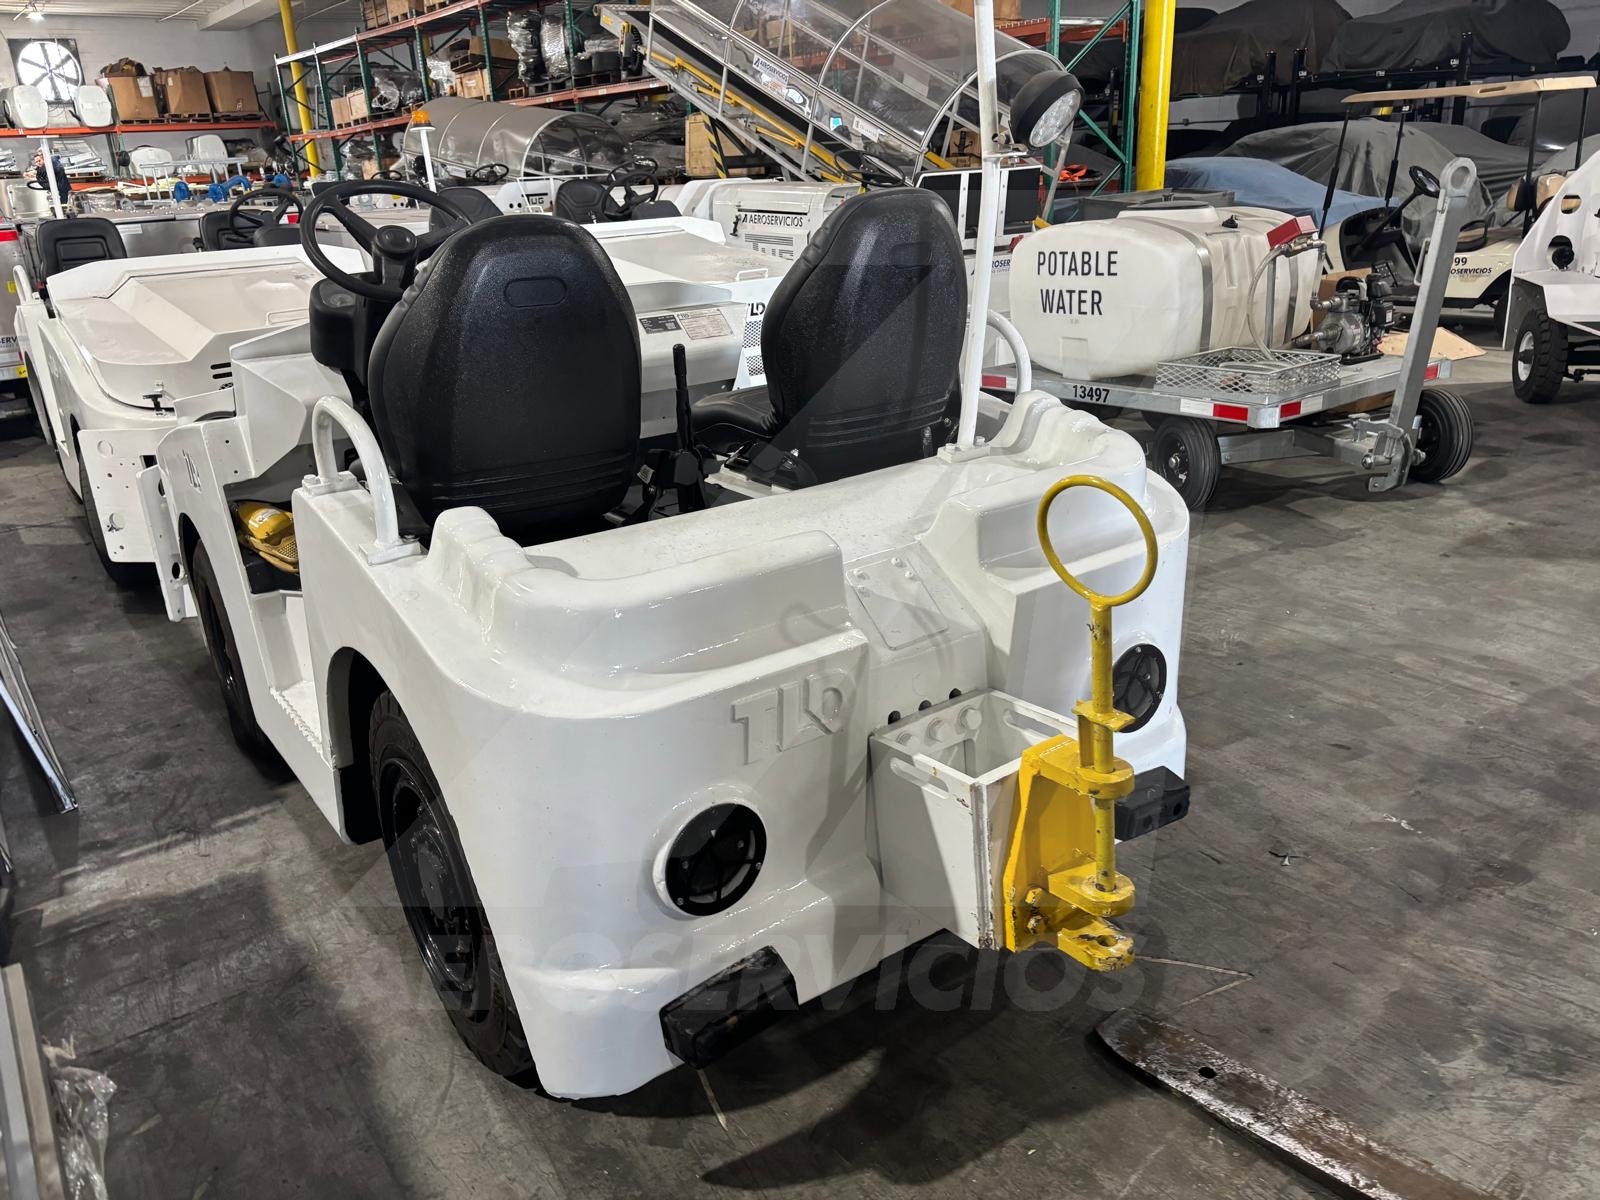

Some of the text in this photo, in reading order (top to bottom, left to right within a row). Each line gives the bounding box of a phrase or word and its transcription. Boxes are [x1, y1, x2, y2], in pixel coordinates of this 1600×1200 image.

[748, 214, 803, 228] AEROSERVICIOS
[1037, 250, 1118, 277] POTABLE
[1454, 256, 1468, 267] 99
[1450, 267, 1493, 275] OSERVICIOS
[748, 302, 766, 317] LD
[1040, 288, 1103, 316] WATER
[1072, 384, 1110, 403] 13497
[729, 668, 851, 766] TLD
